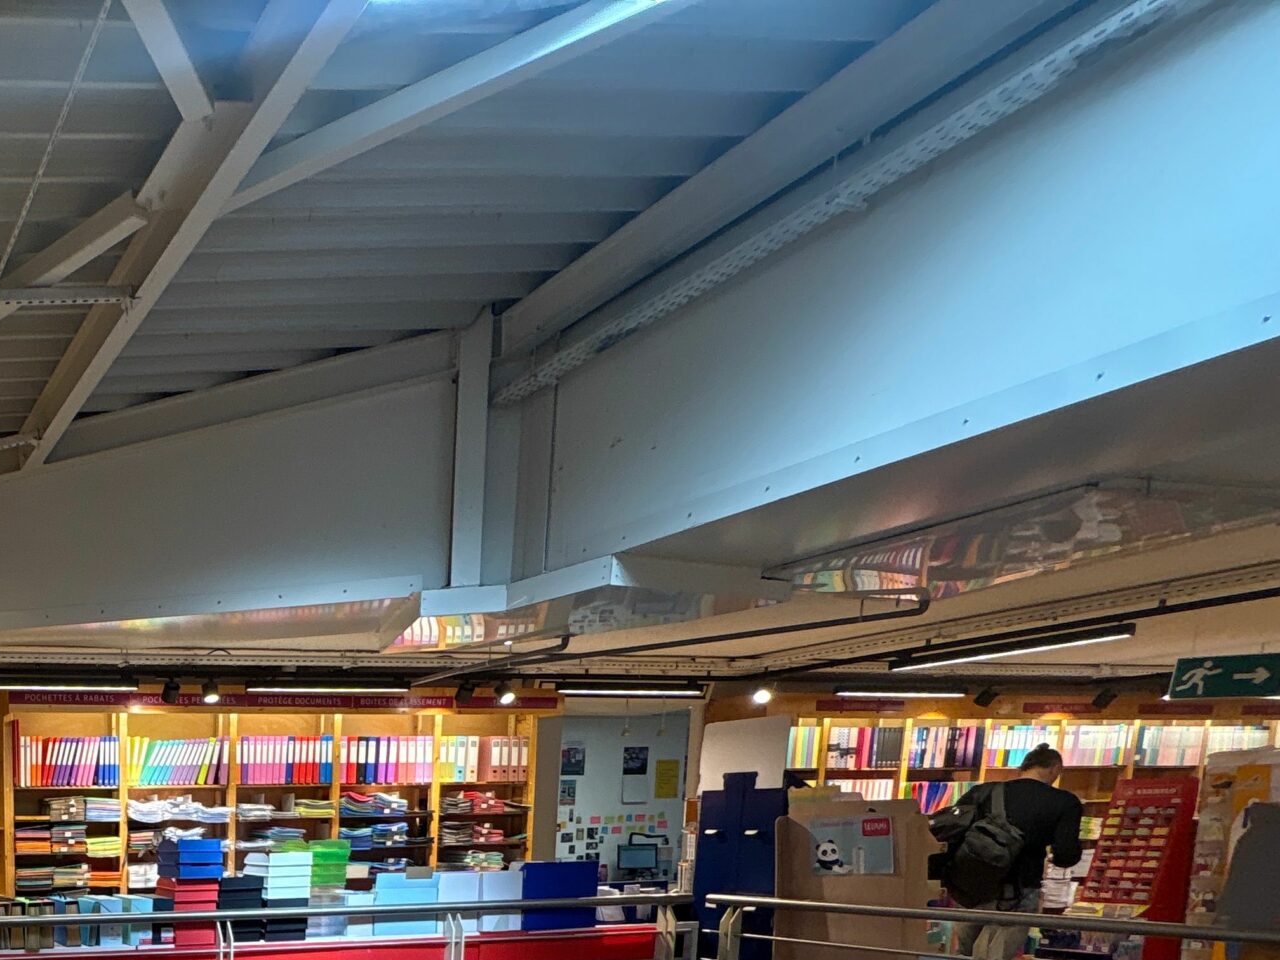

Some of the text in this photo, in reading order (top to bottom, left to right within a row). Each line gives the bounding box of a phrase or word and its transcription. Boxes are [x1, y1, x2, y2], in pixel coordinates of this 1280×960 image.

[24, 693, 71, 703] POCHETTES
[83, 693, 115, 703] RABATS
[257, 694, 342, 705] PROTÈGE DOCUMENTS
